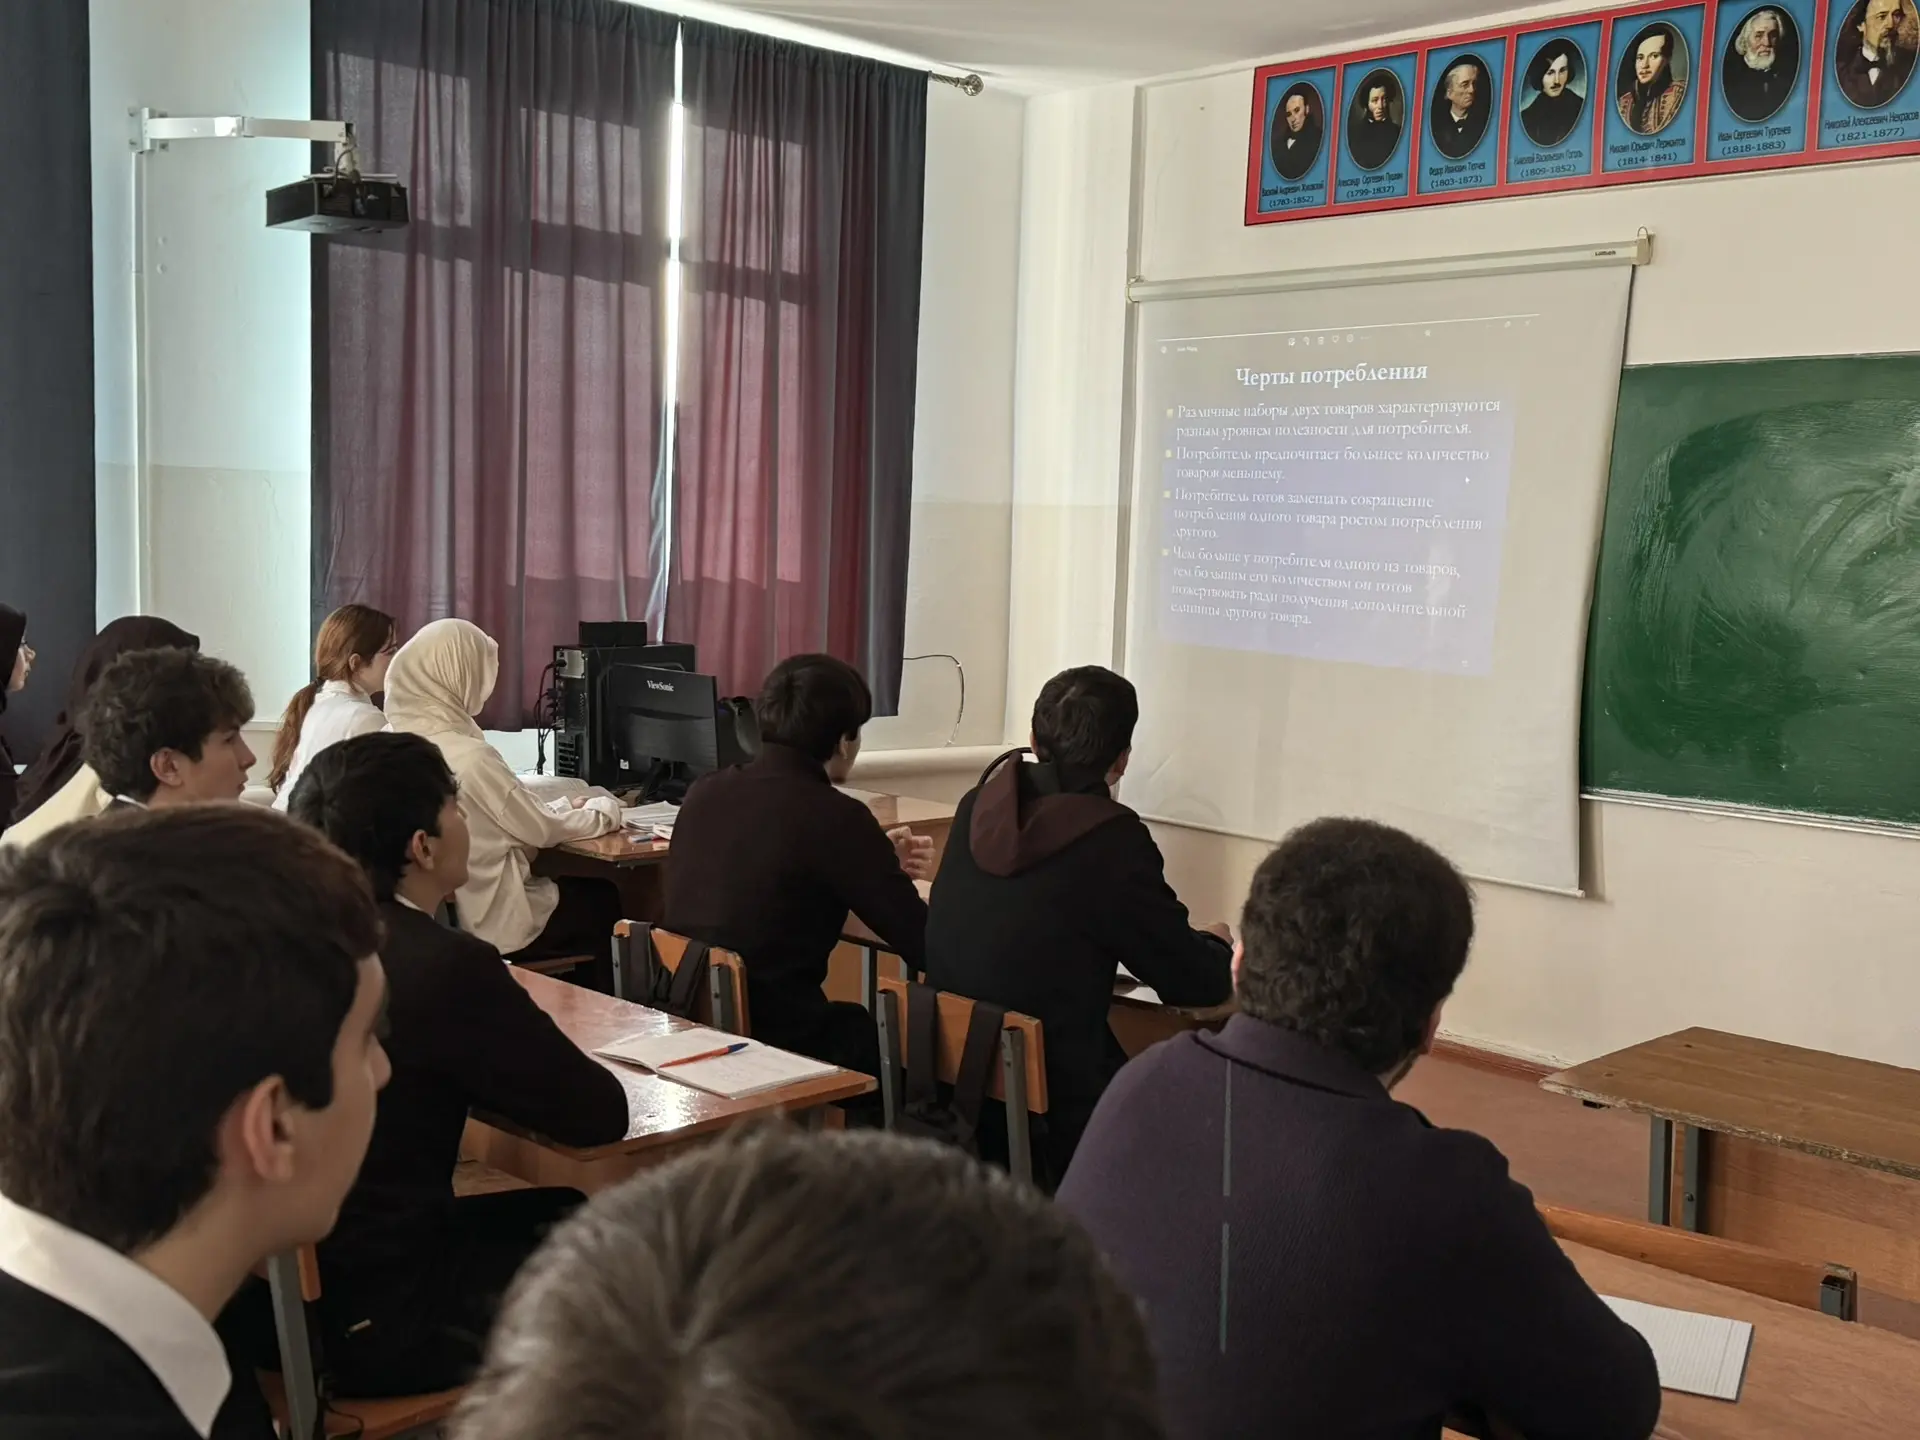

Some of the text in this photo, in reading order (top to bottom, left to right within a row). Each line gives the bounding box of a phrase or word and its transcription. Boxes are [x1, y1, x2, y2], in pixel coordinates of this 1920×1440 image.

[1835, 127, 1905, 143] (1821-1877)
[1722, 140, 1785, 155] (1818-1883)
[1618, 152, 1677, 167] (1814-1841)
[1520, 164, 1576, 177] (1809-1852)
[1430, 175, 1482, 189] (1803-1873)
[1346, 186, 1395, 198] (1799-1837)
[1236, 363, 1428, 390] Черты потребления
[1178, 401, 1500, 420] Различные наборы двух товаров характеризуются
[1222, 426, 1270, 440] уровнем
[1275, 426, 1347, 436] полезности
[1378, 420, 1471, 439] потребителя.
[1176, 447, 1251, 463] Потребитель
[1344, 447, 1402, 460] большее
[1407, 450, 1489, 460] количество
[1175, 488, 1249, 504] Потребитель
[1252, 494, 1284, 503] готов
[1174, 508, 1482, 532] потребления одного товара ростом потребления
[1174, 546, 1460, 580] Чем больше у потребителя одного из товаров,
[1355, 581, 1371, 590] он
[1376, 583, 1412, 593] готов
[1250, 591, 1277, 604] ради
[1351, 601, 1467, 618] дополнительной
[1223, 608, 1266, 620] другого
[1271, 612, 1311, 626] товара.
[647, 680, 674, 692] ViewSonic
